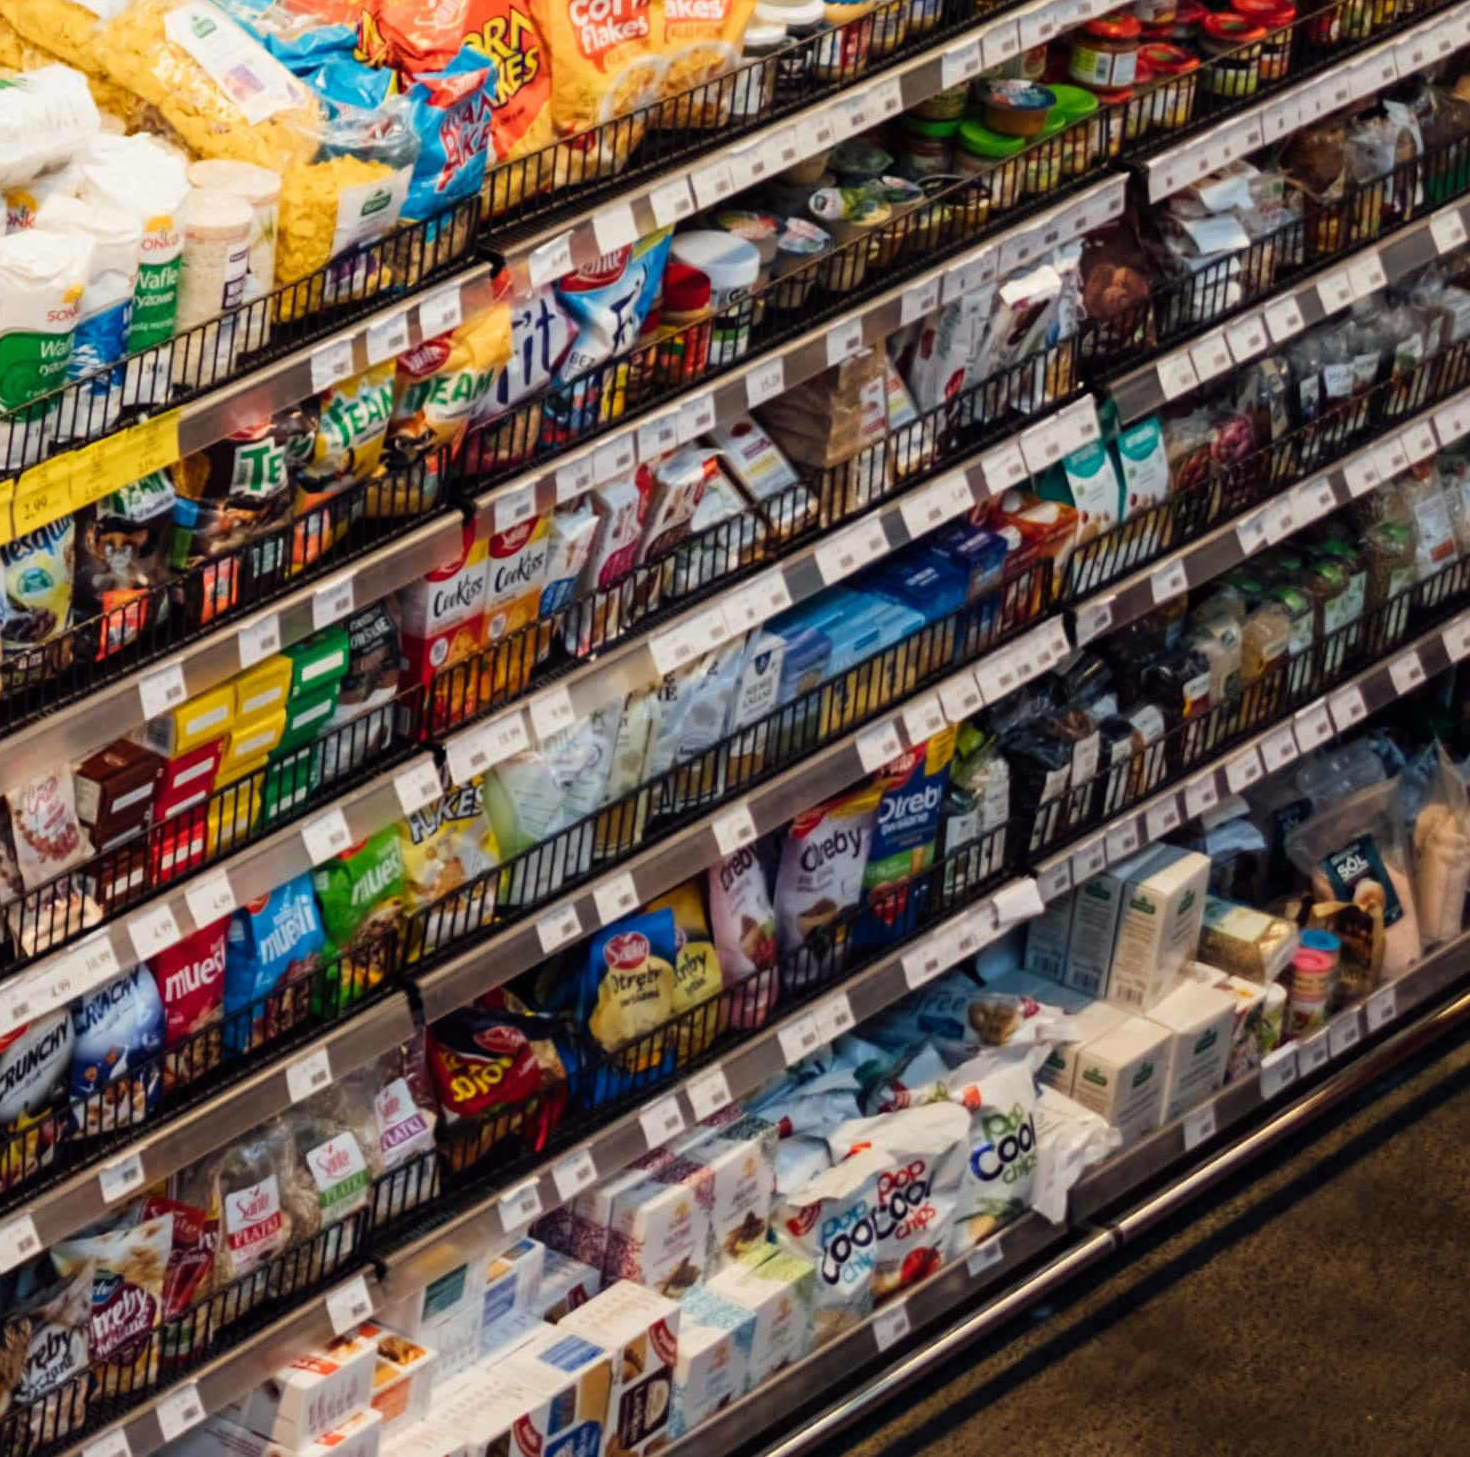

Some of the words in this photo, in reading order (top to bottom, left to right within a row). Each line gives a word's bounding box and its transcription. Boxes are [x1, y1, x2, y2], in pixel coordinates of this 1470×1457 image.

[462, 6, 538, 57] ORN
[581, 14, 650, 55] flakes
[46, 306, 80, 324] SON
[232, 1215, 280, 1247] PŁATKI
